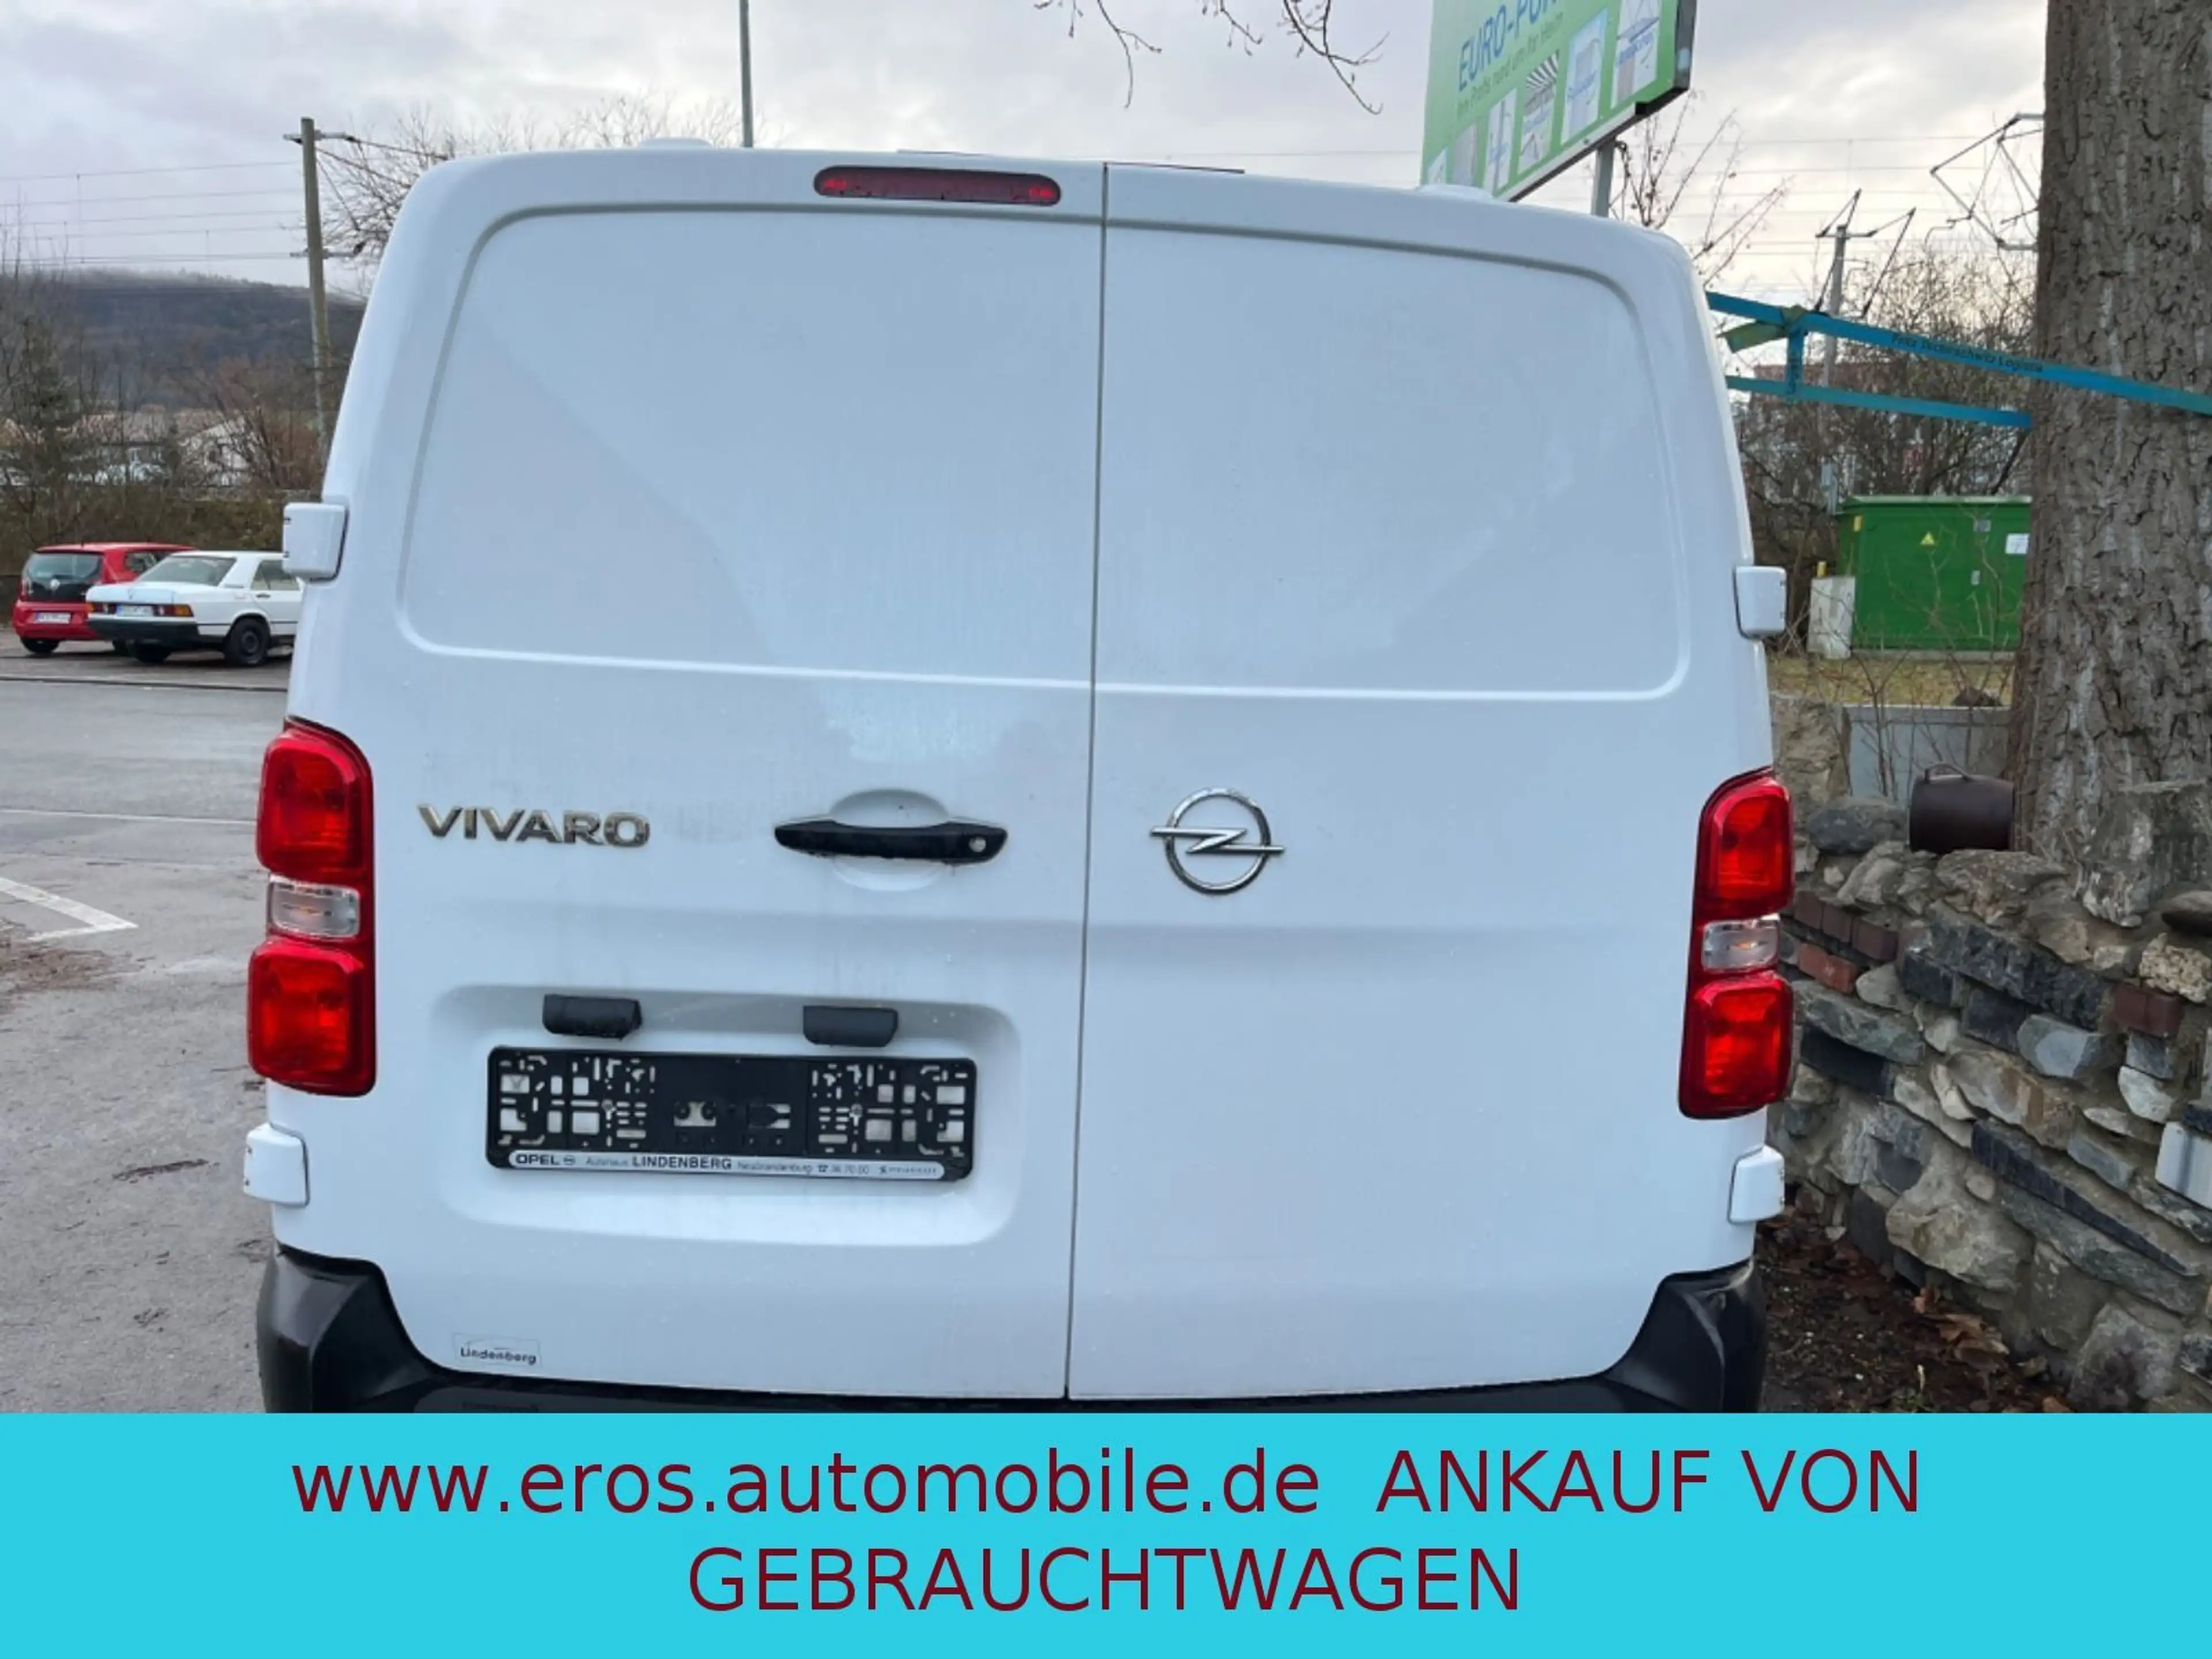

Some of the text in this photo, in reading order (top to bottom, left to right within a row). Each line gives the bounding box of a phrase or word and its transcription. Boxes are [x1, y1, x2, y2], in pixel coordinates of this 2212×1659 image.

[418, 804, 650, 849] VIVARO
[515, 1153, 560, 1166] OPEL
[632, 1155, 732, 1170] LINDENBERG
[460, 1346, 536, 1366] Lindenberg
